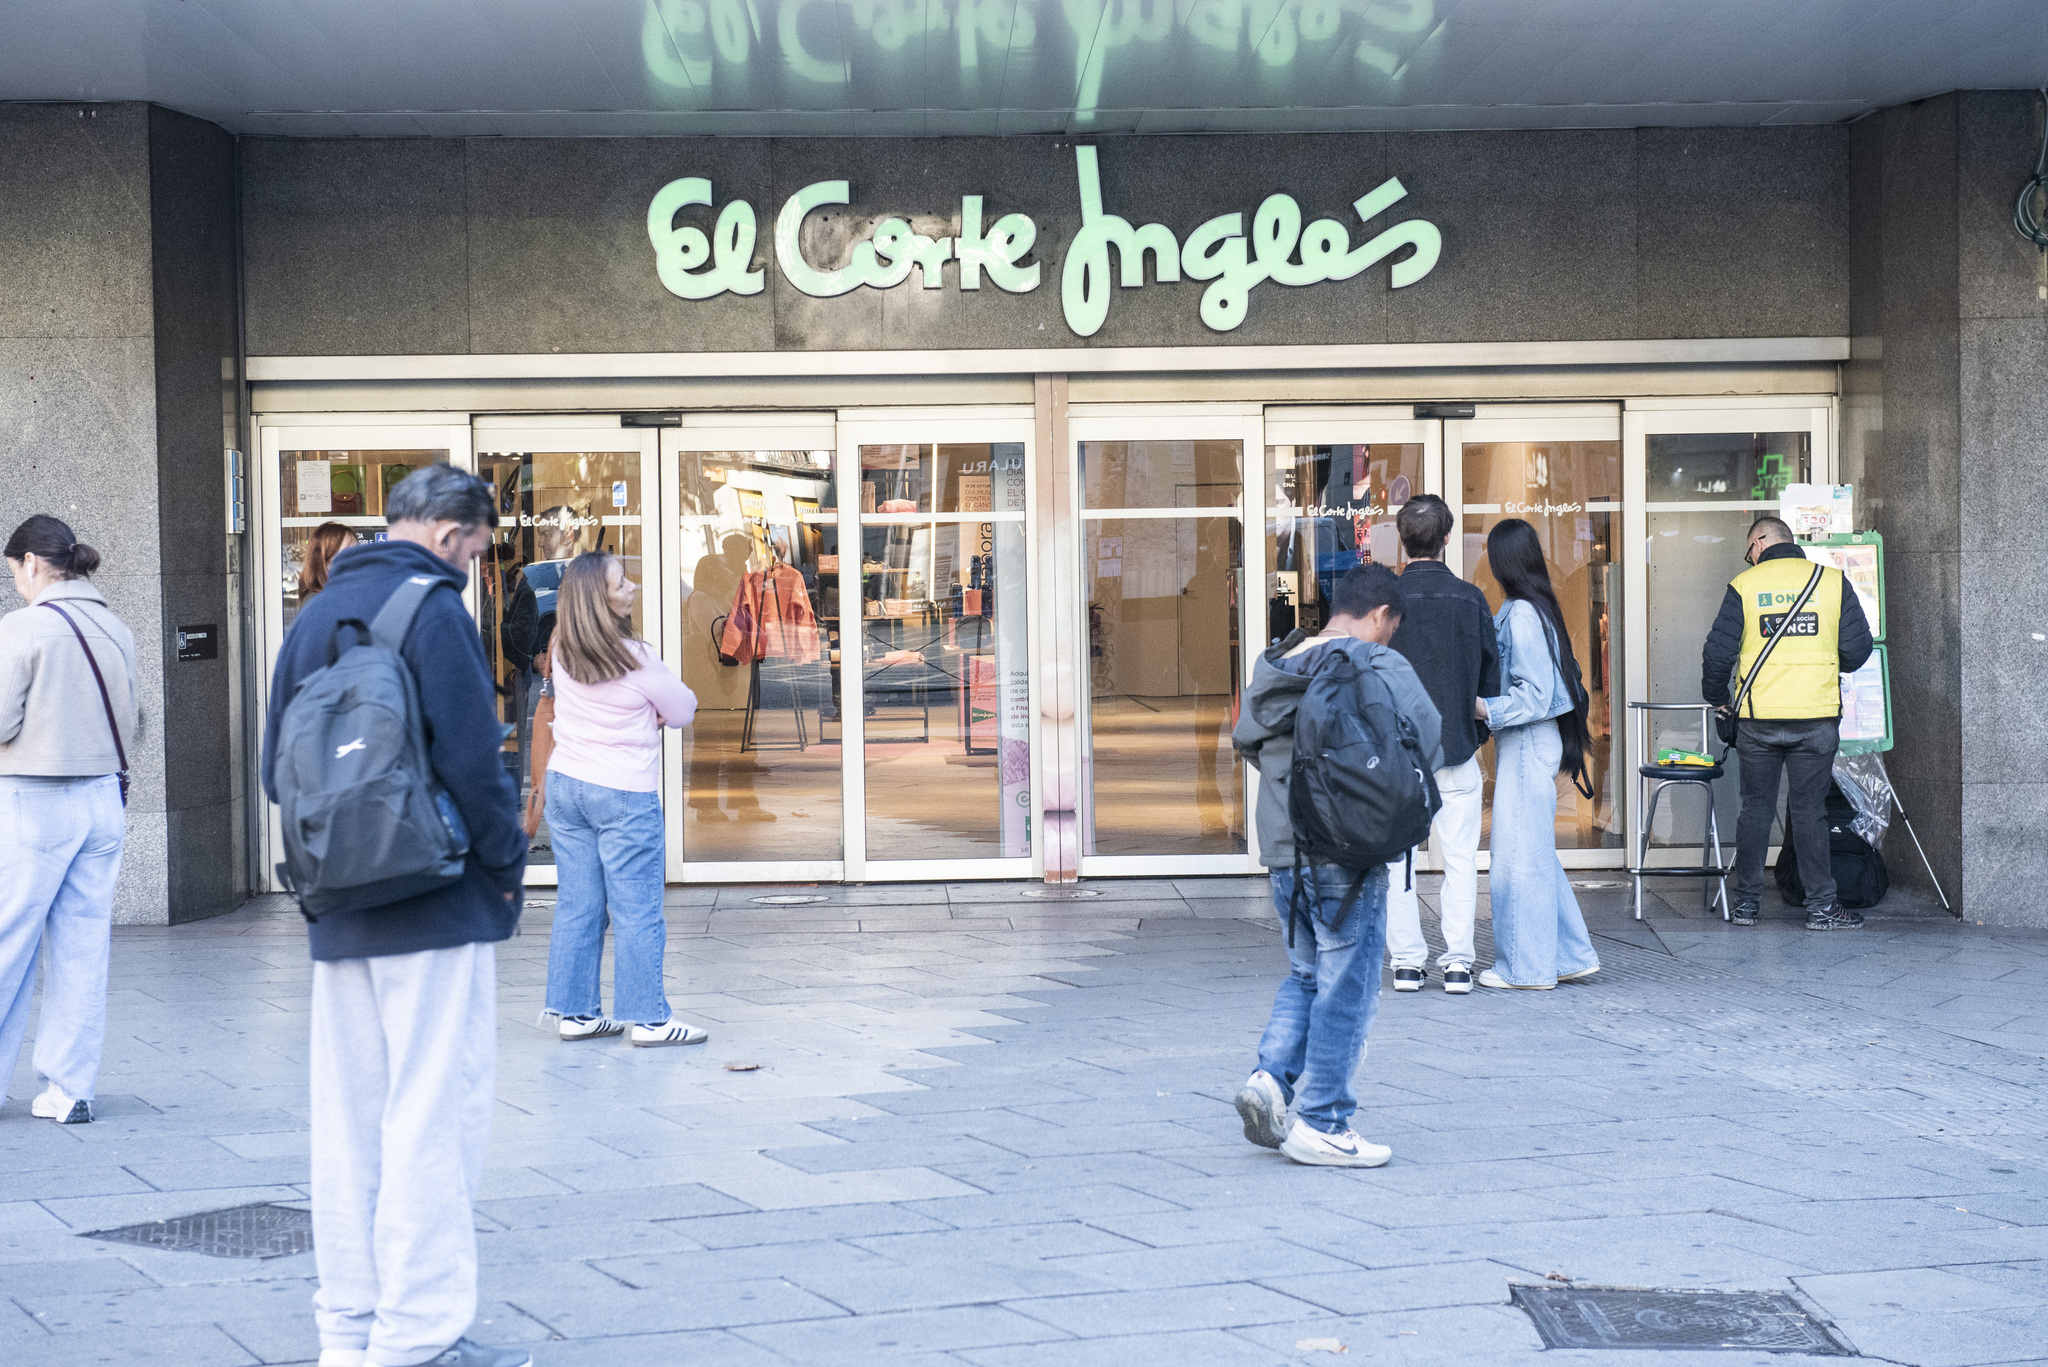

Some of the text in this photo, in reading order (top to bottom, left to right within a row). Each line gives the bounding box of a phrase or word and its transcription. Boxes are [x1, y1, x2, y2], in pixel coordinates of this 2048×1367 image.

[647, 145, 1442, 337] El Corte Inglés
[1007, 489, 1019, 497] EL
[1307, 501, 1384, 520] El Corte Inglés
[1505, 498, 1581, 517] El Corte Inglés
[520, 514, 532, 527] El
[532, 514, 559, 527] Corte
[1796, 614, 1816, 622] social
[1776, 623, 1816, 634] NCE
